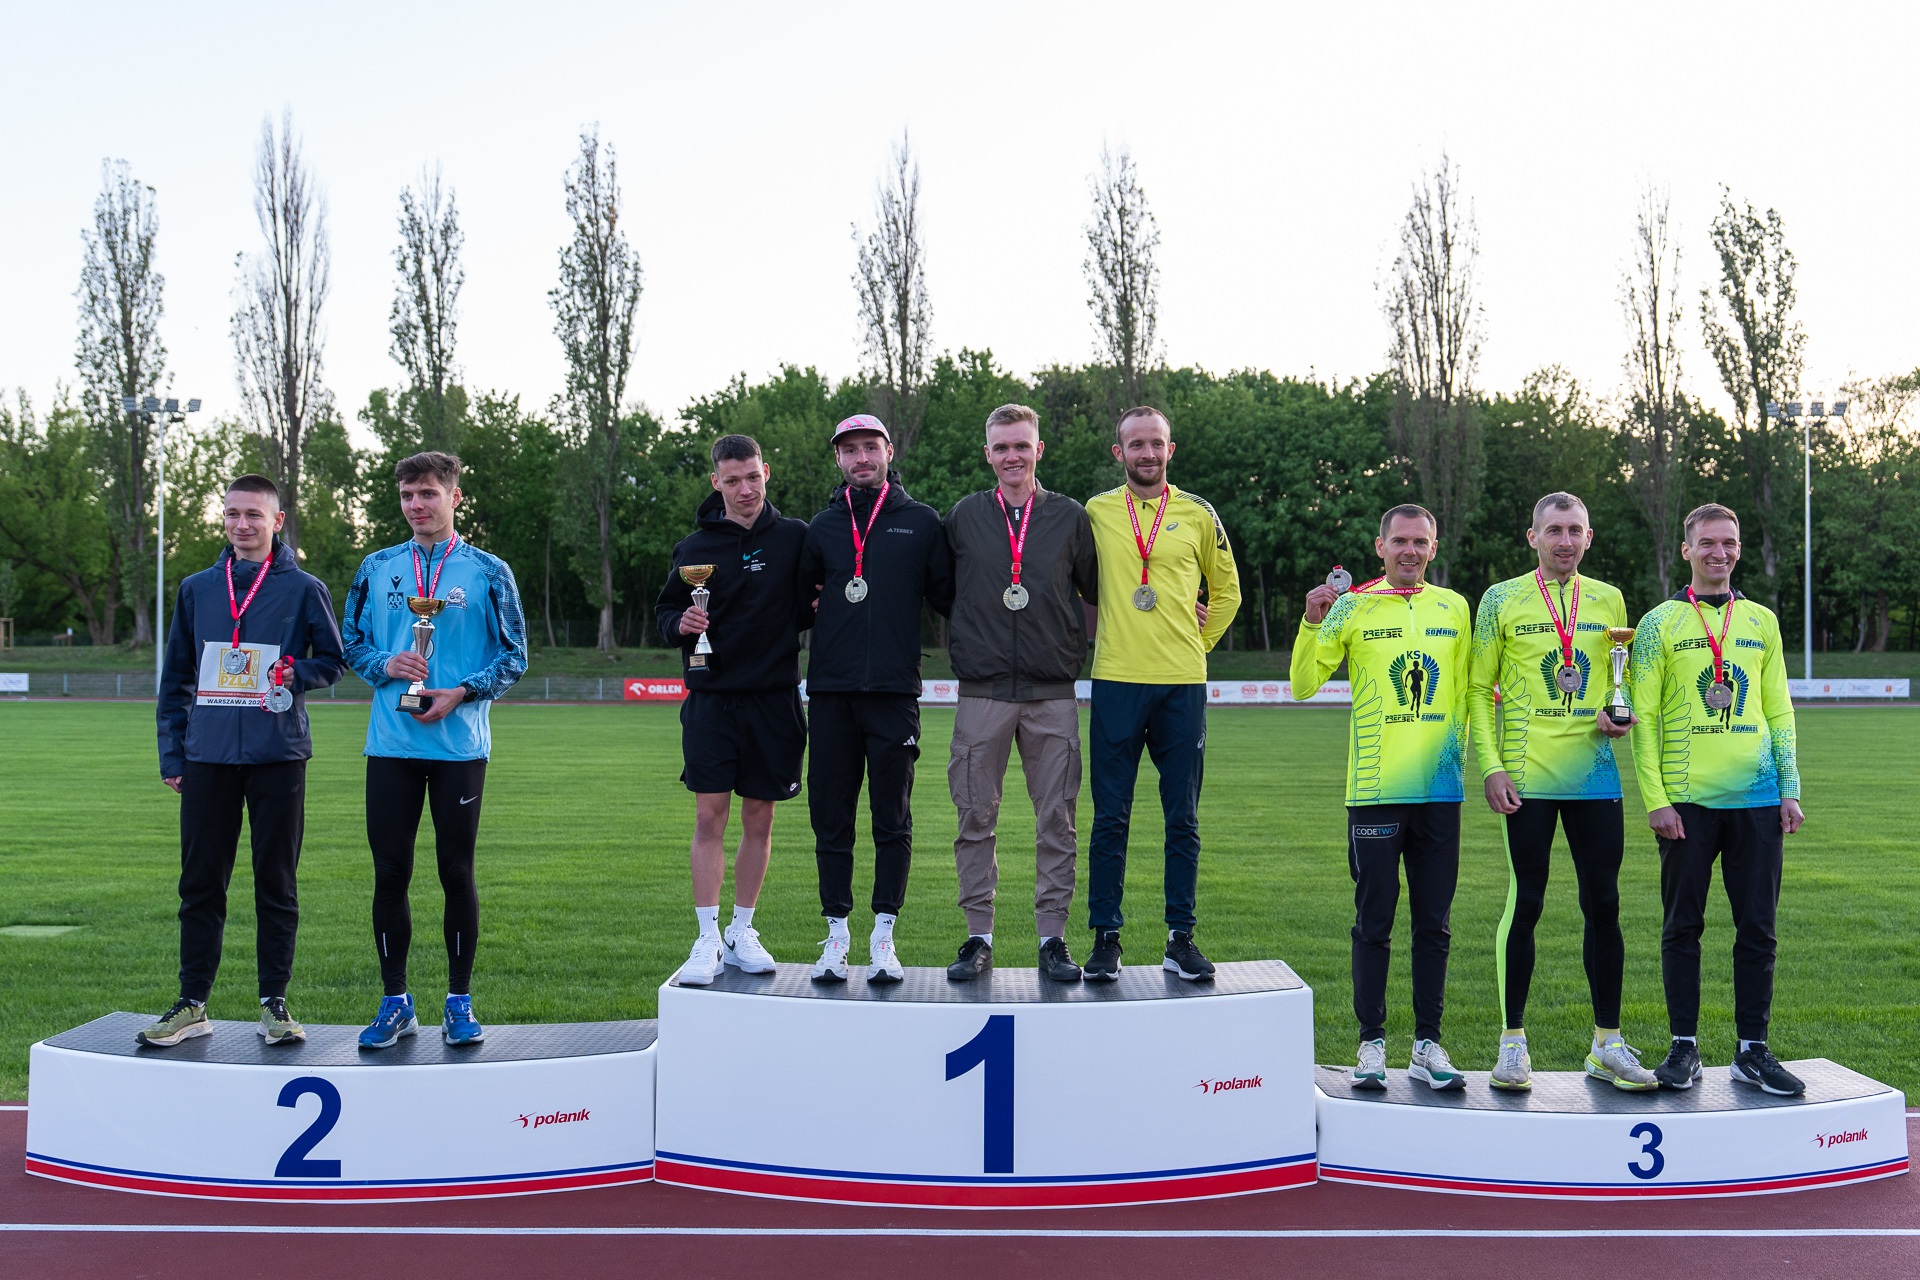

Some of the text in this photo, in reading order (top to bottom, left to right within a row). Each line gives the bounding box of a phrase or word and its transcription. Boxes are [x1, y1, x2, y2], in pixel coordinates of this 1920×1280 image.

[1406, 650, 1421, 659] KS
[220, 675, 255, 687] PZLA
[648, 685, 682, 694] ORLEN
[1356, 827, 1396, 836] CODETWO
[945, 1014, 1014, 1173] 1
[1213, 1075, 1263, 1094] polanik
[274, 1076, 342, 1178] 2
[533, 1108, 591, 1129] polanik
[1827, 1128, 1868, 1148] polanik
[1627, 1122, 1665, 1180] 3
